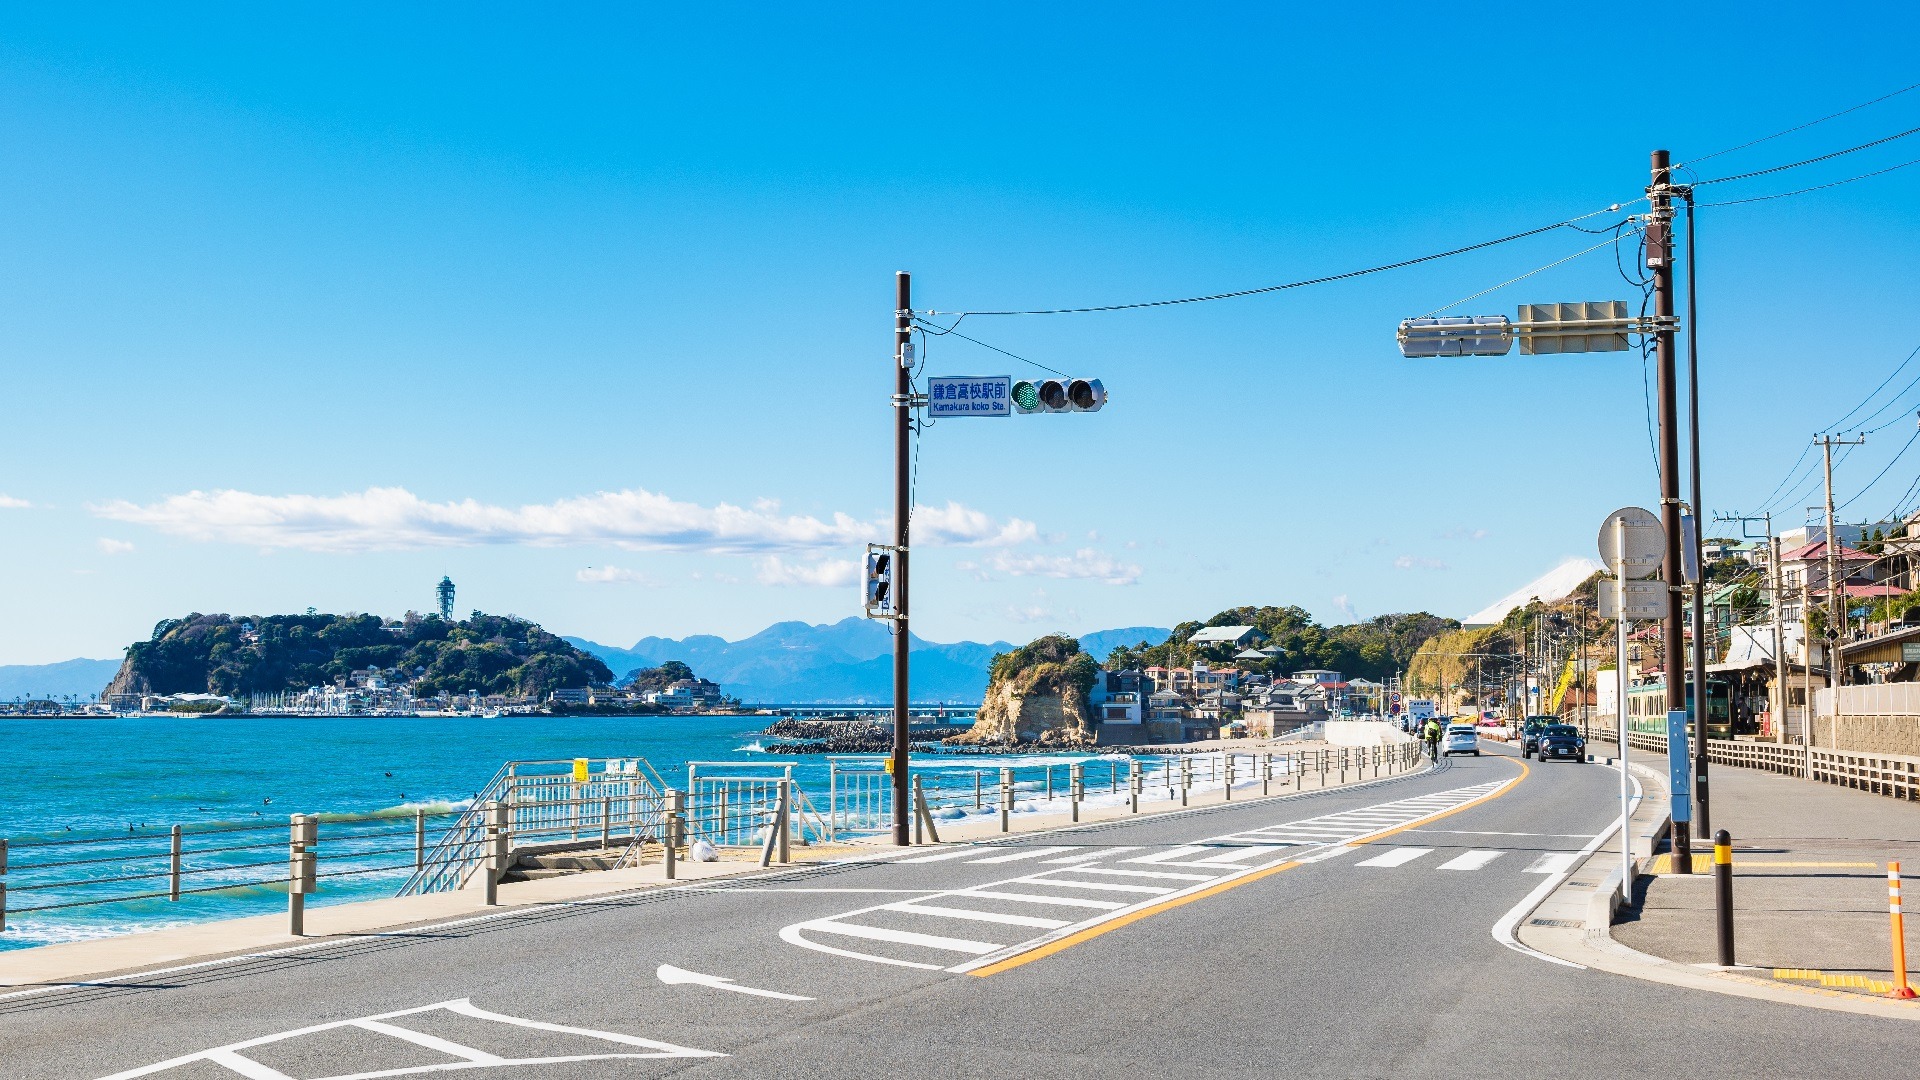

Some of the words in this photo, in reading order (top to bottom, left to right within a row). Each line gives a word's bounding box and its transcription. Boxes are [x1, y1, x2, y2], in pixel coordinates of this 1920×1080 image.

[933, 382, 1006, 400] 鎌倉高校駅前
[933, 402, 969, 412] Kamakura
